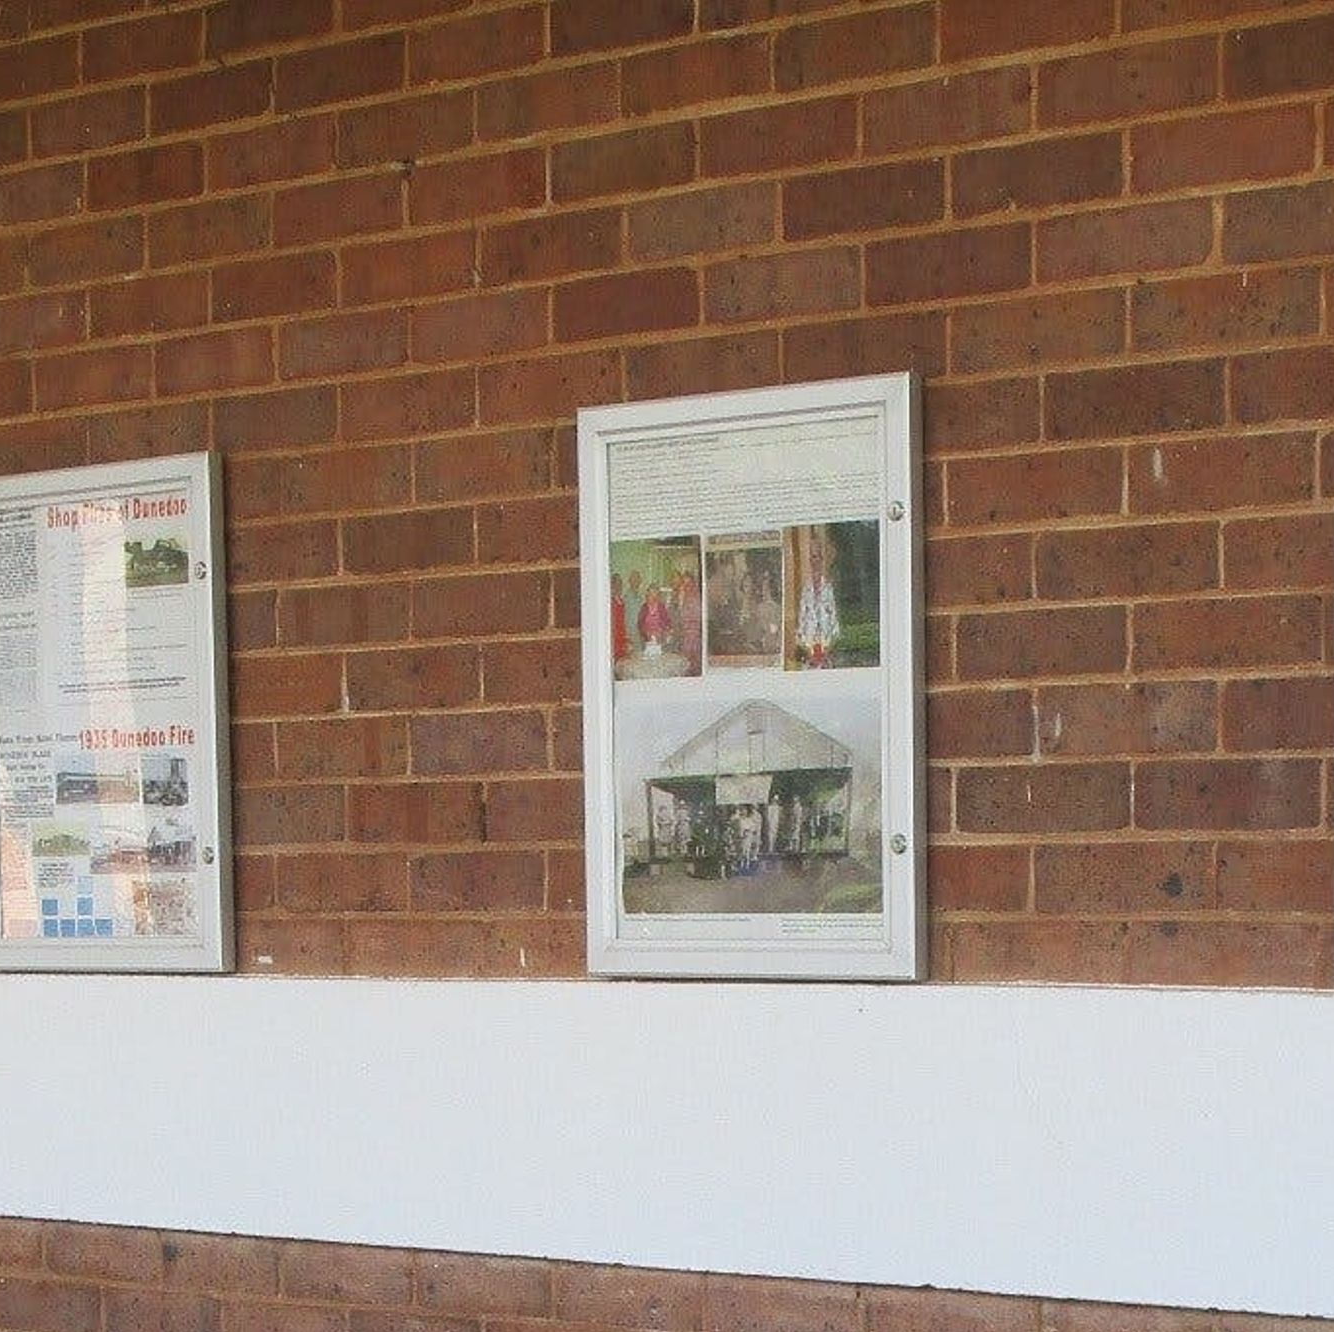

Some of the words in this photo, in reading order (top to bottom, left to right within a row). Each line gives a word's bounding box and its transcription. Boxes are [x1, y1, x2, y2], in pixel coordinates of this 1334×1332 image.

[47, 506, 78, 531] Shop
[132, 495, 188, 519] Dunedoo
[112, 728, 165, 748] Dunedoo
[168, 724, 196, 745] Fire
